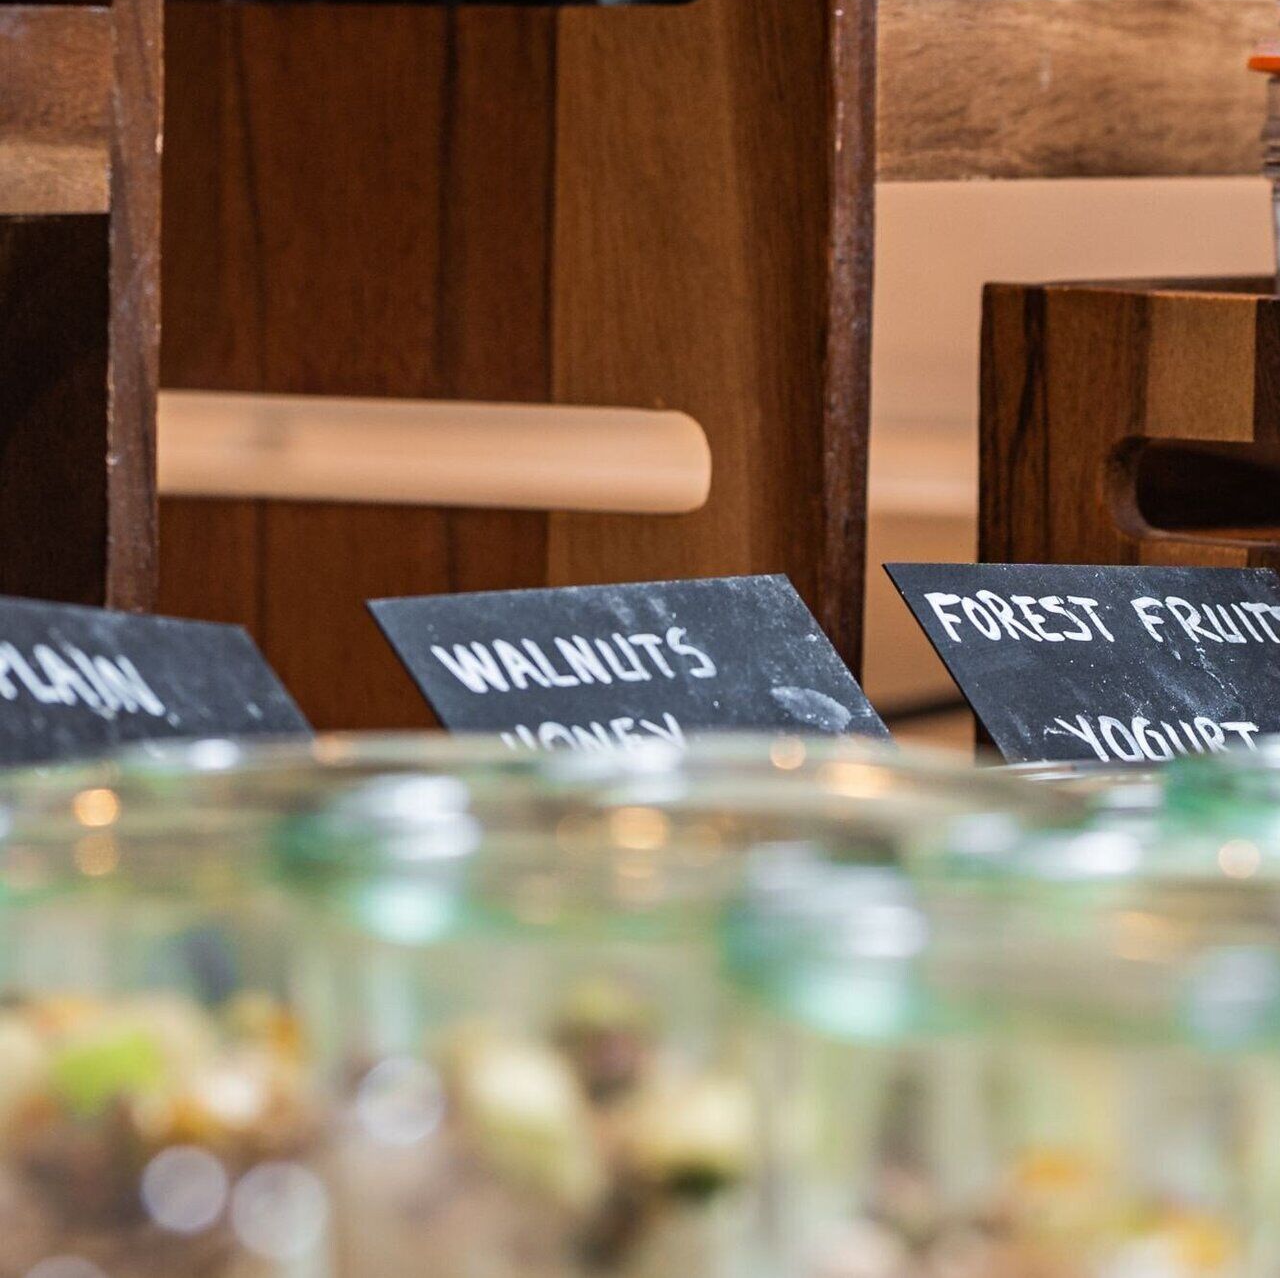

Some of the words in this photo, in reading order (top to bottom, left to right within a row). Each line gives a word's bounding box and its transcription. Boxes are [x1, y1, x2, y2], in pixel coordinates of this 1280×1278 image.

[924, 589, 1115, 643] FOREST
[430, 626, 717, 694] WALNUTS
[1050, 714, 1259, 763] YOGURT
